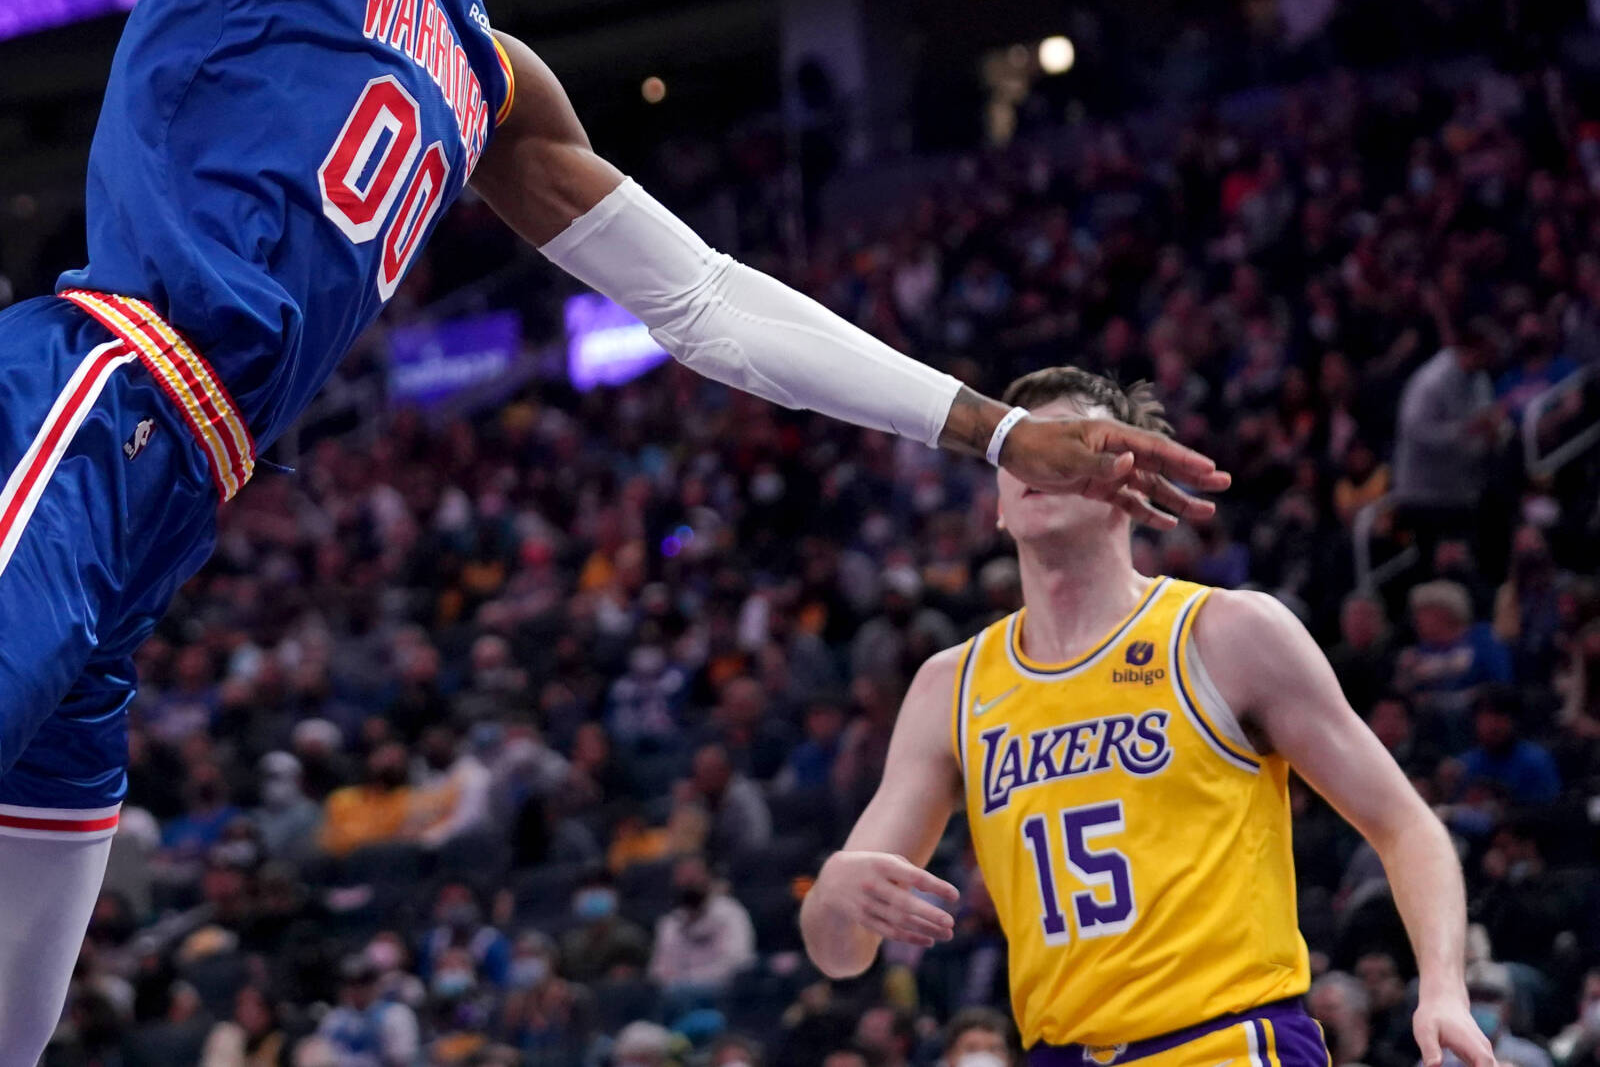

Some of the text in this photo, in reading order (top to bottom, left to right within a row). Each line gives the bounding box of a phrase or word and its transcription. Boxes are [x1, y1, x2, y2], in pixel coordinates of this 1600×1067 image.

[317, 74, 450, 303] 00
[1112, 668, 1165, 686] bibigo
[979, 710, 1172, 816] LAKERS
[1021, 799, 1138, 947] 15
